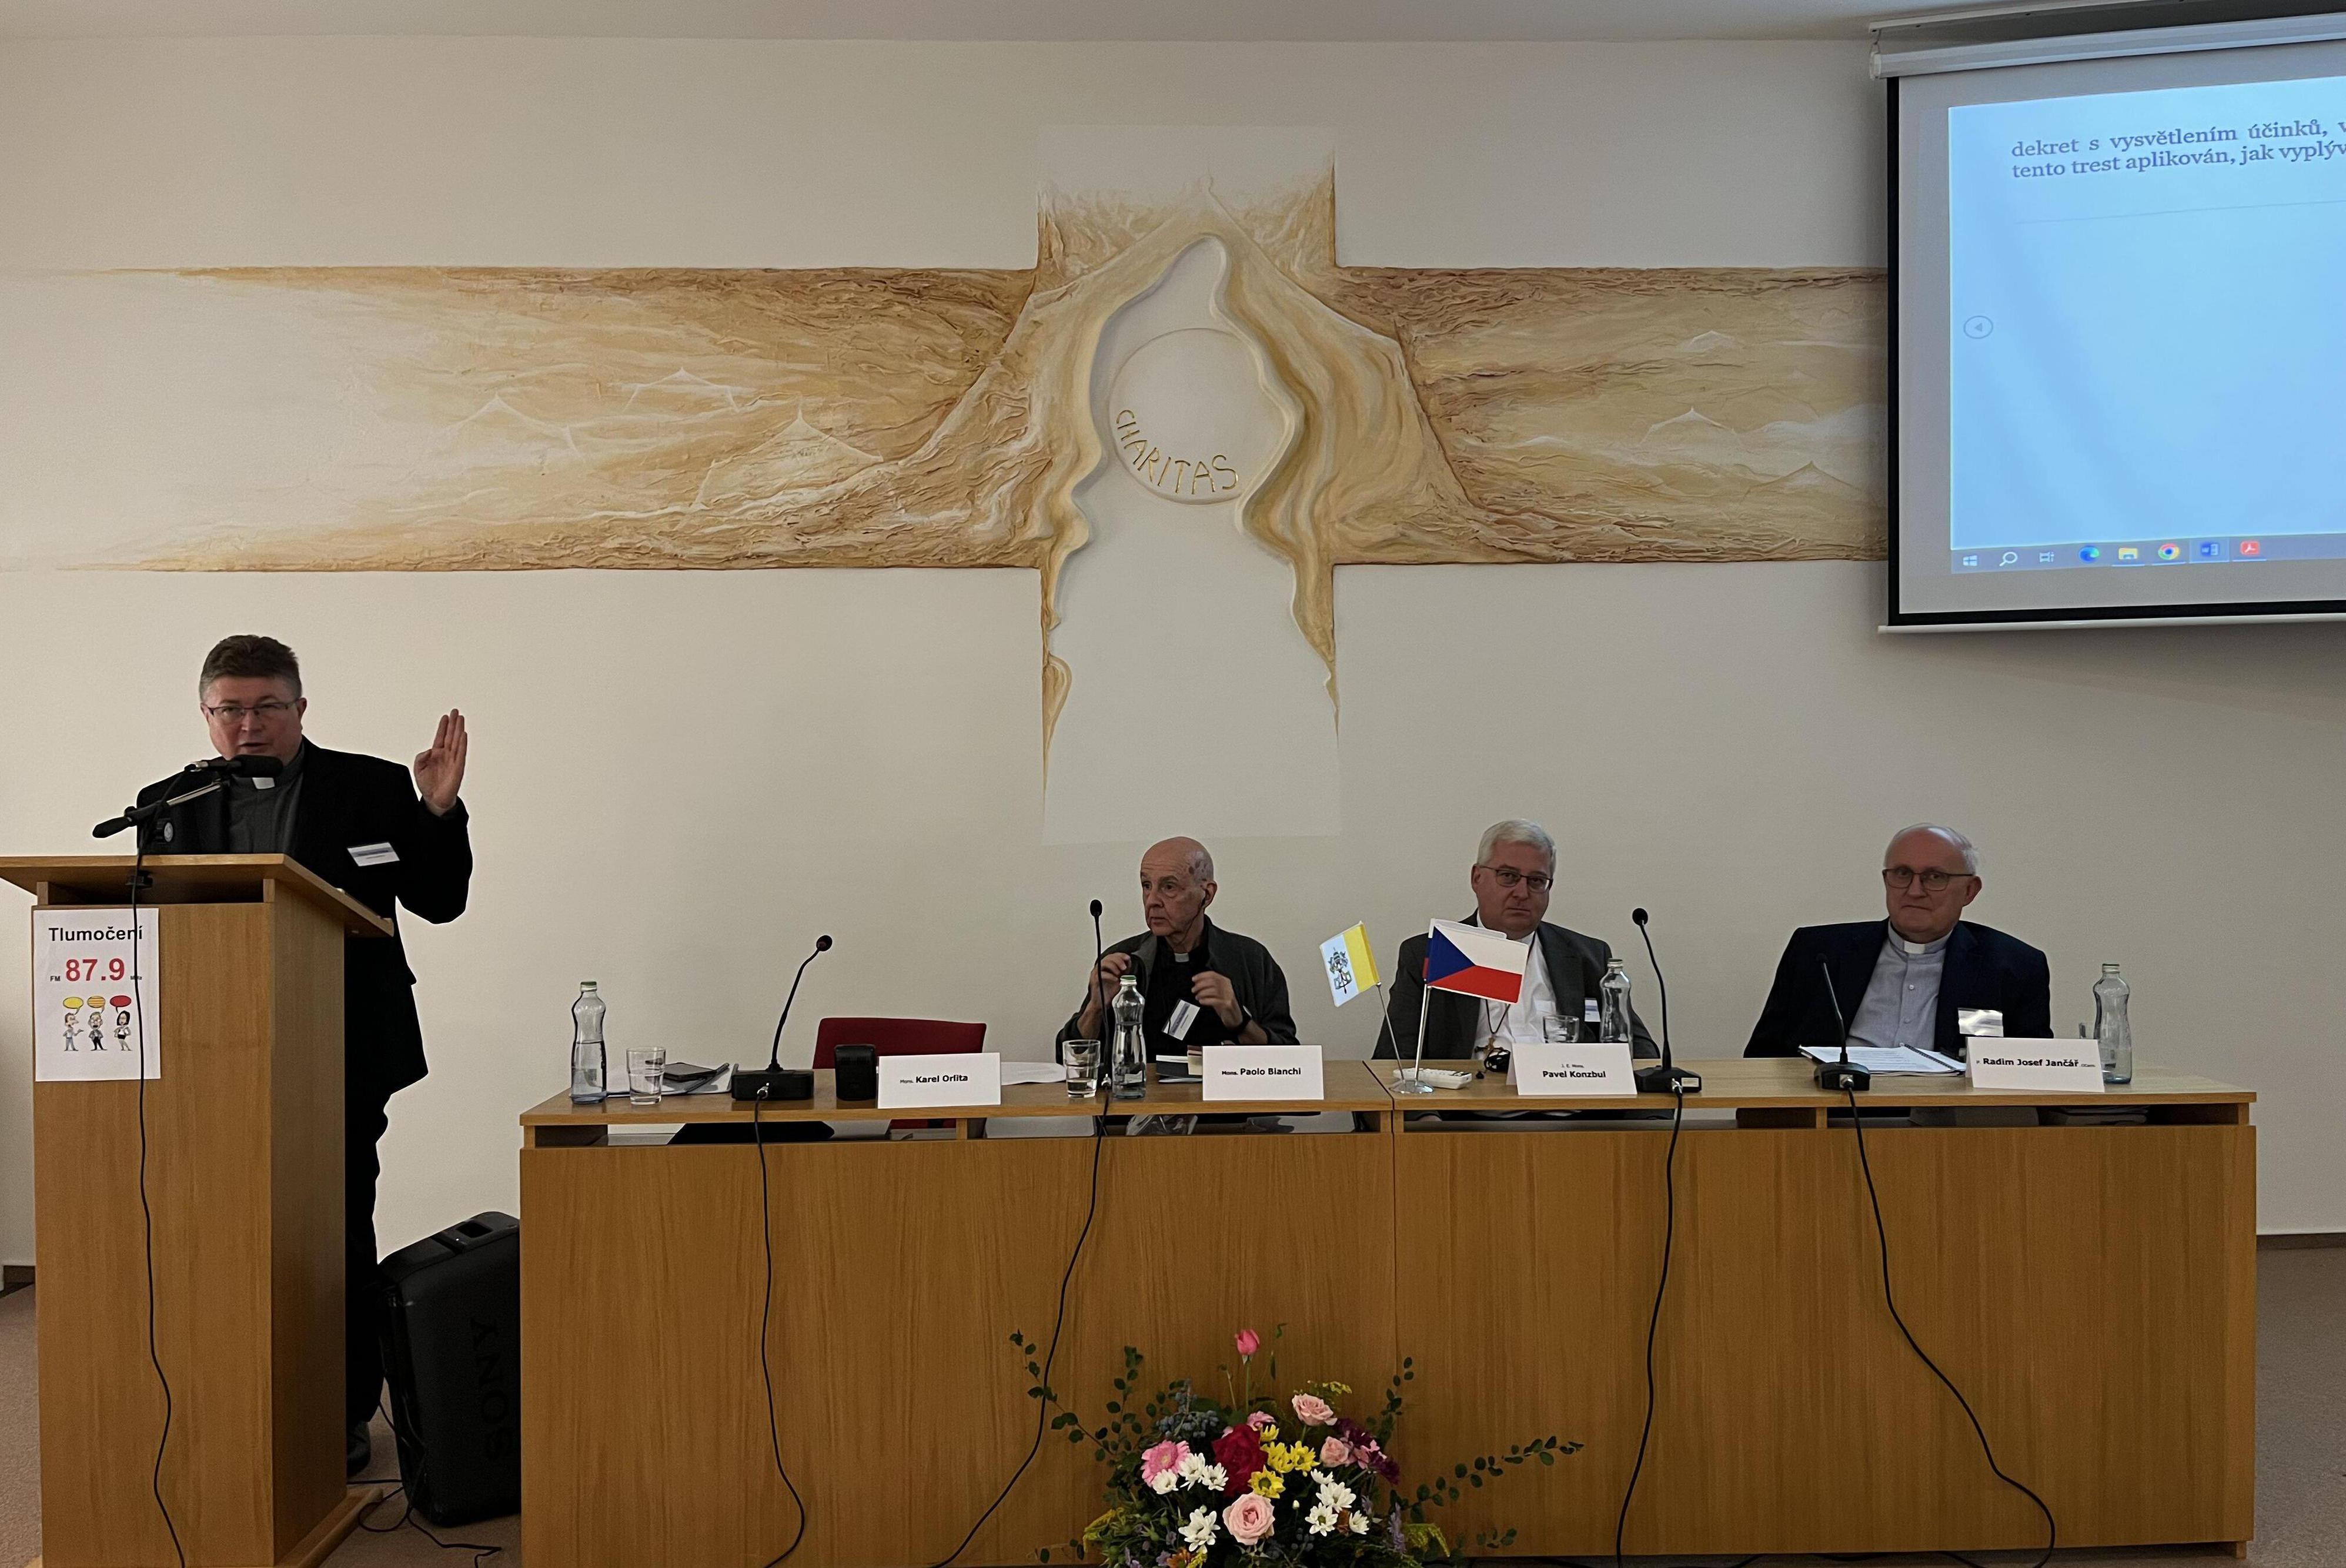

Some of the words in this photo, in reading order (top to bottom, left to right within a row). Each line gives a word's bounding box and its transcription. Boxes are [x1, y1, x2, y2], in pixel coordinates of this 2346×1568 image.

[2011, 139, 2079, 157] dekret
[2089, 139, 2100, 151] s
[2110, 126, 2238, 152] vysvětlením
[2248, 119, 2328, 139] účinků,
[2012, 162, 2065, 178] tento
[2071, 156, 2121, 174] trest
[2126, 148, 2235, 172] aplikován,
[2239, 144, 2274, 165] jak
[2278, 140, 2346, 162] vyplýv
[1117, 409, 1239, 494] CHARITAS
[48, 925, 142, 941] Tlumočení
[66, 958, 125, 982] 87.9
[470, 1316, 513, 1461] SONY
